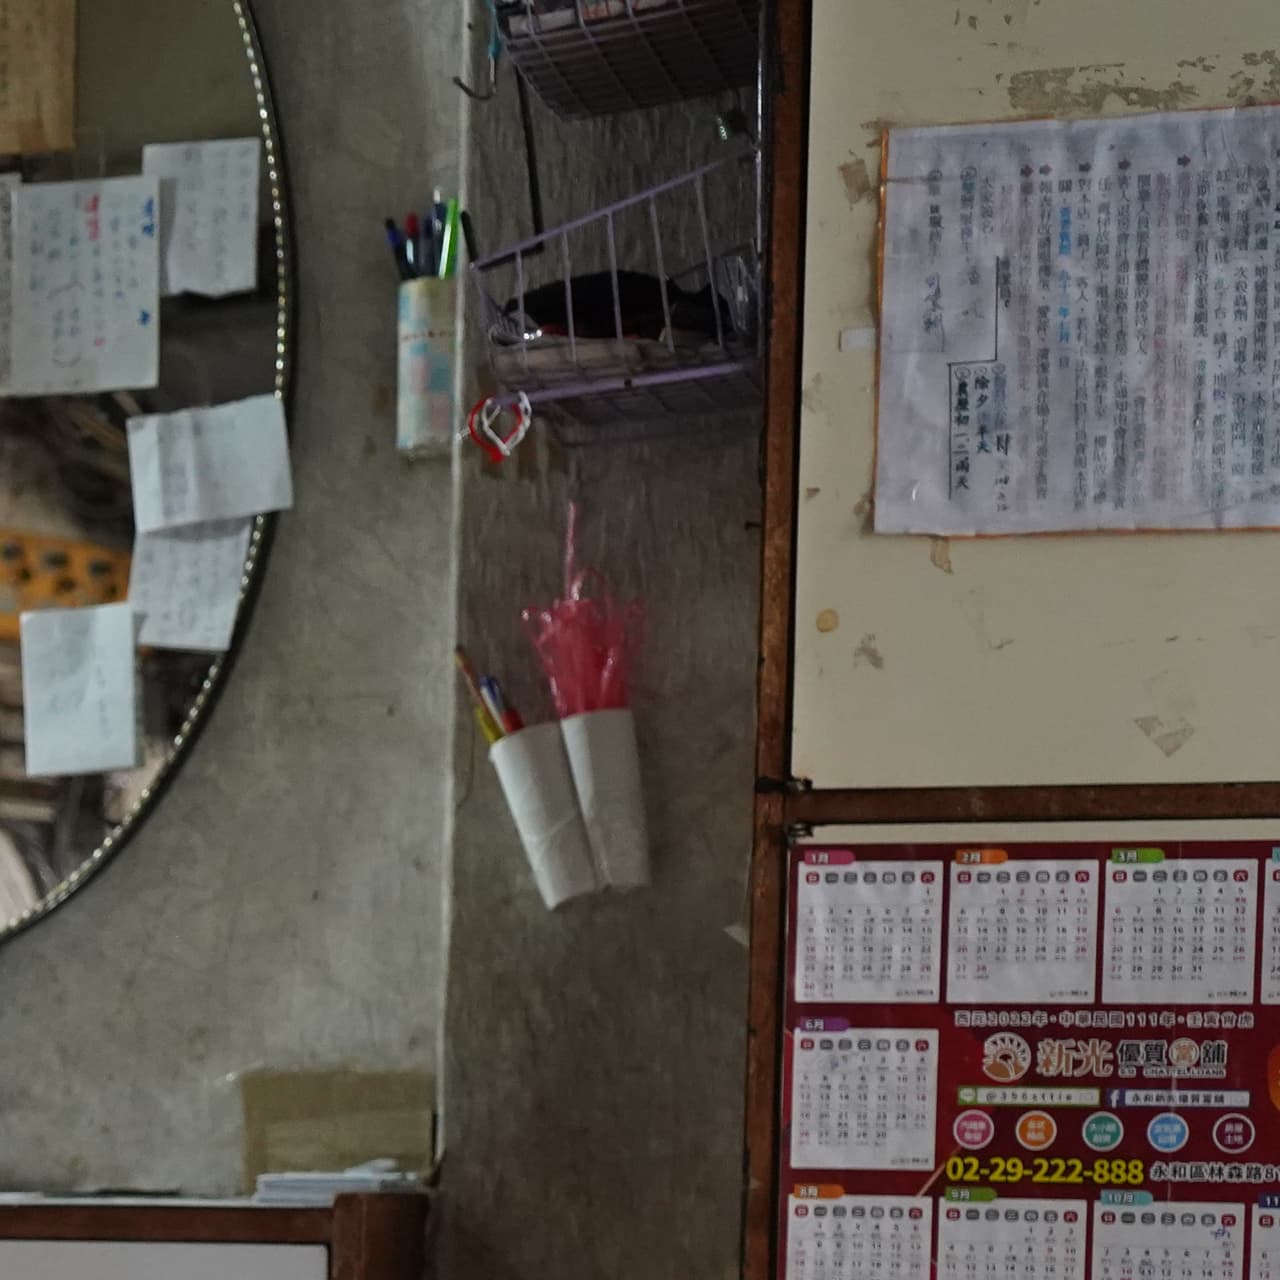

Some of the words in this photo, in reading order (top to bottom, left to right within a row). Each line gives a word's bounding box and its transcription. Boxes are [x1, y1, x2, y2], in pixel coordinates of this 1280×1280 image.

[946, 1157, 1145, 1184] 02-29-222-888
[1151, 1161, 1280, 1184] 永和區林森路8
